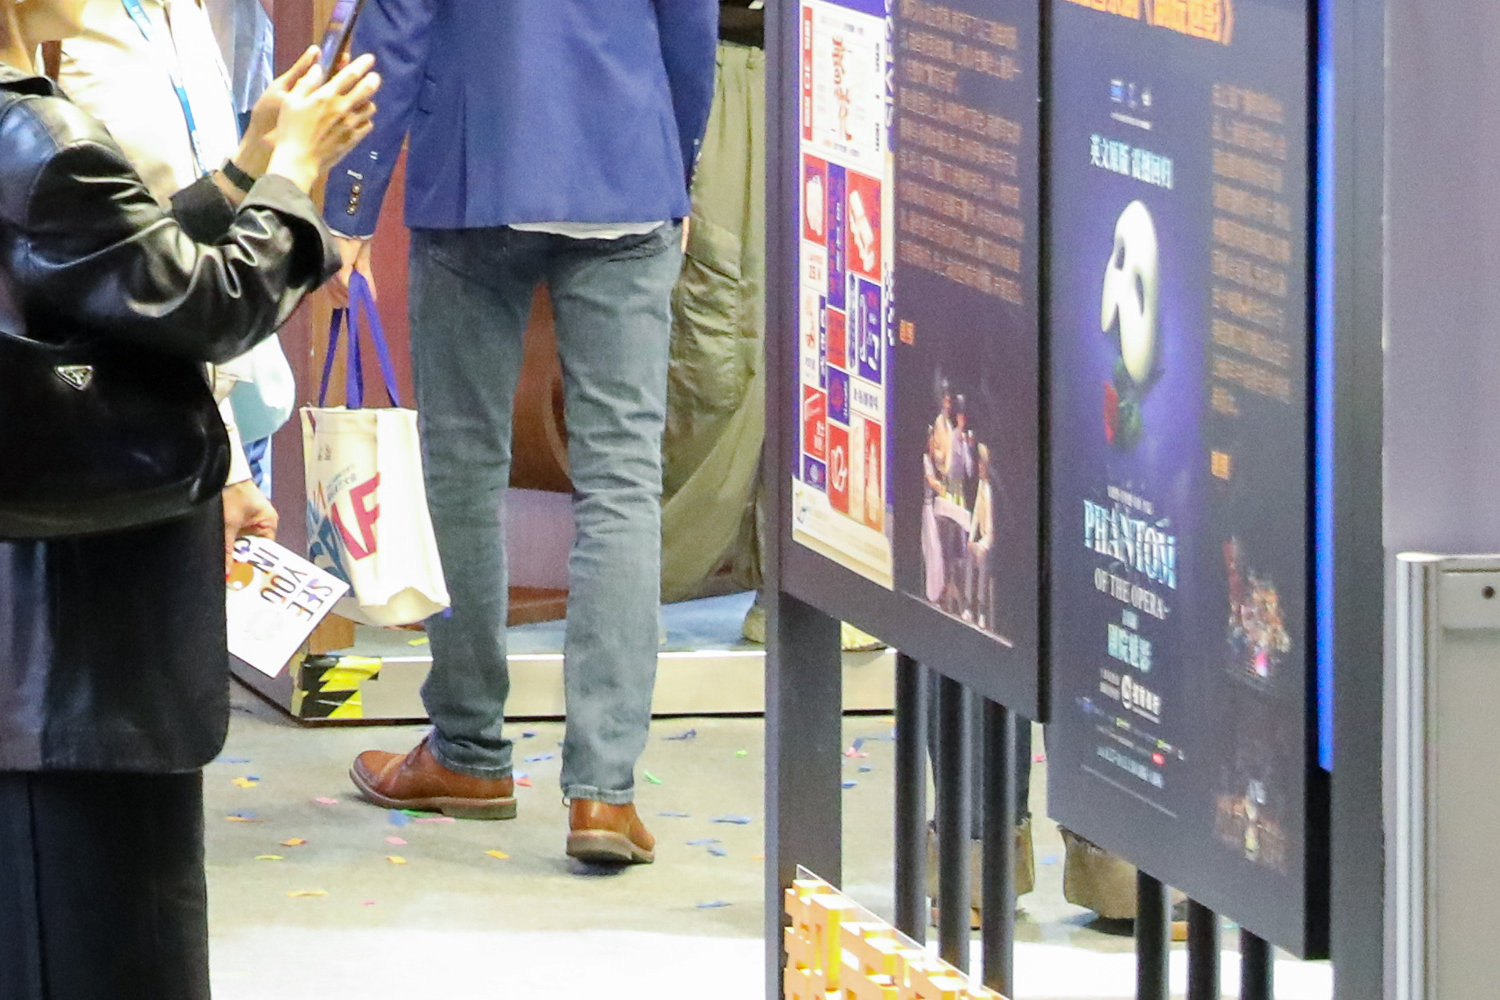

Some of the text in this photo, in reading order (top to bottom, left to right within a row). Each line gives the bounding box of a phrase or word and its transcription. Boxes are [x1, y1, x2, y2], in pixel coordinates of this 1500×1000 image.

[1083, 499, 1177, 590] PHANTOM
[260, 566, 308, 604] YOU
[286, 578, 333, 622] SEE
[1094, 567, 1166, 620] OF THE OPERA
